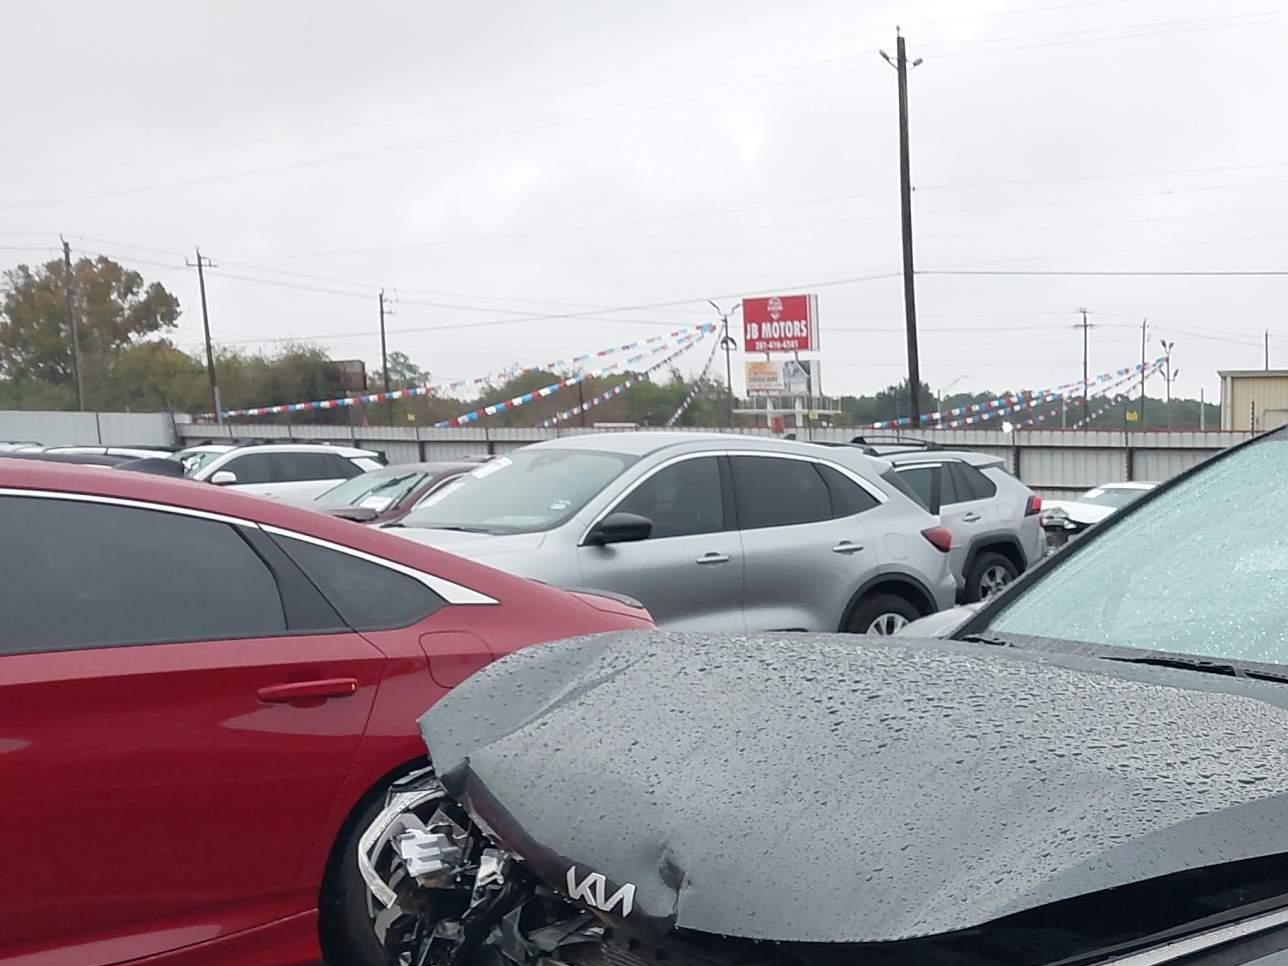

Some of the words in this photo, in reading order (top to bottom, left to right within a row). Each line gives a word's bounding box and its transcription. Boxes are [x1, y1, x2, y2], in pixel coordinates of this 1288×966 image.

[746, 322, 759, 340] JB
[761, 320, 807, 339] MOTORS
[566, 865, 636, 918] KIA
